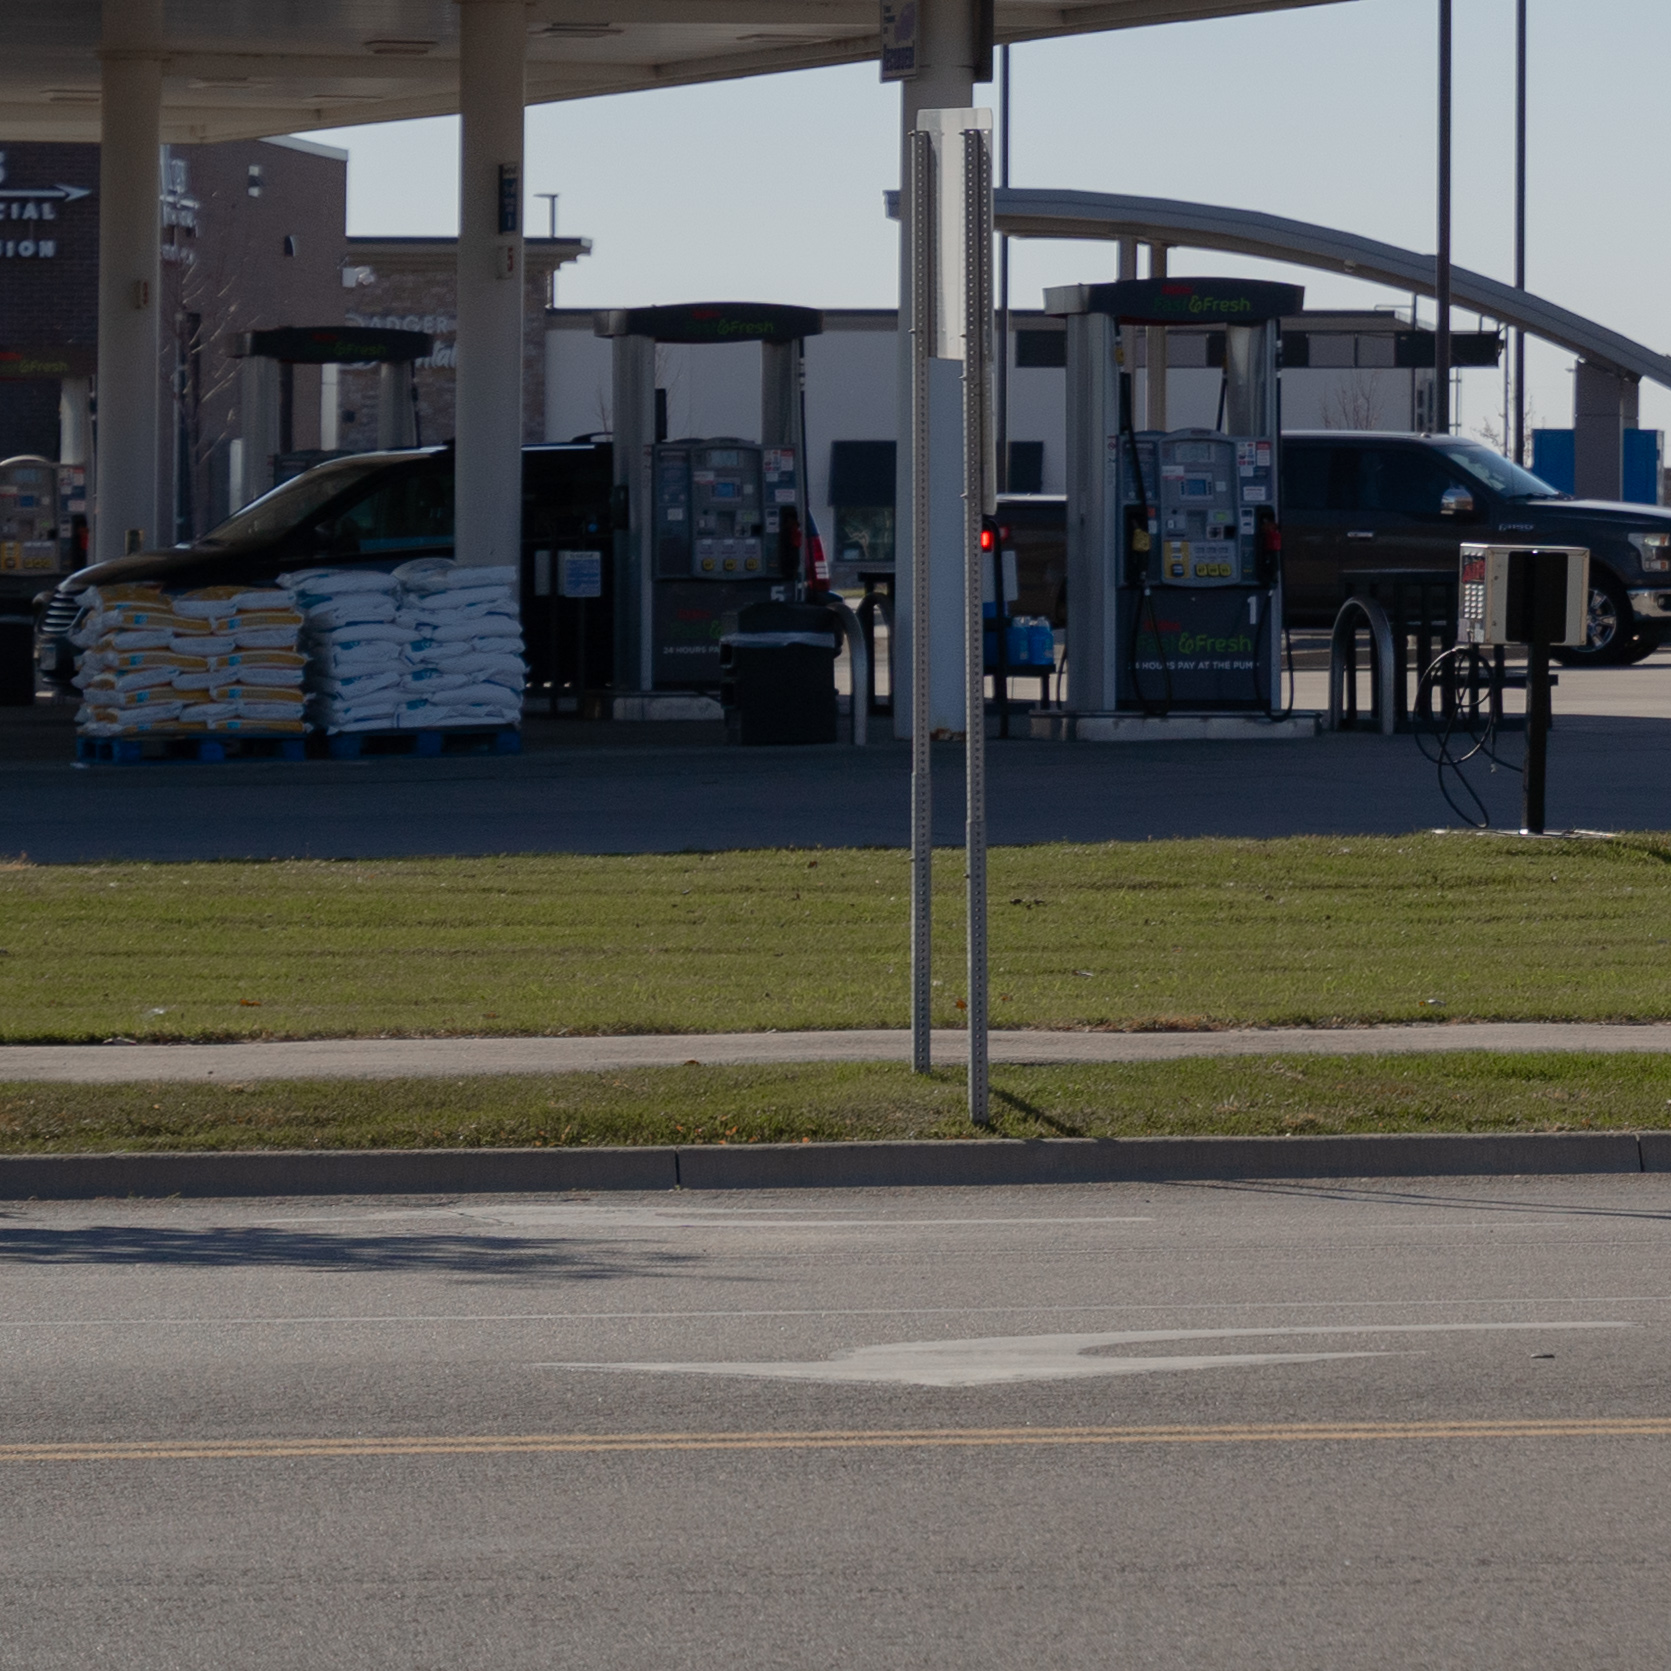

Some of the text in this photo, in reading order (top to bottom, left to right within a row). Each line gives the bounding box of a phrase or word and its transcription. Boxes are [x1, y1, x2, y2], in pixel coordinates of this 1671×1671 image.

[1247, 595, 1258, 624] 1
[709, 646, 721, 654] PA
[1177, 661, 1195, 670] PAY
[1198, 661, 1210, 670] AT
[1213, 661, 1230, 670] THE
[1233, 660, 1259, 669] PUM
